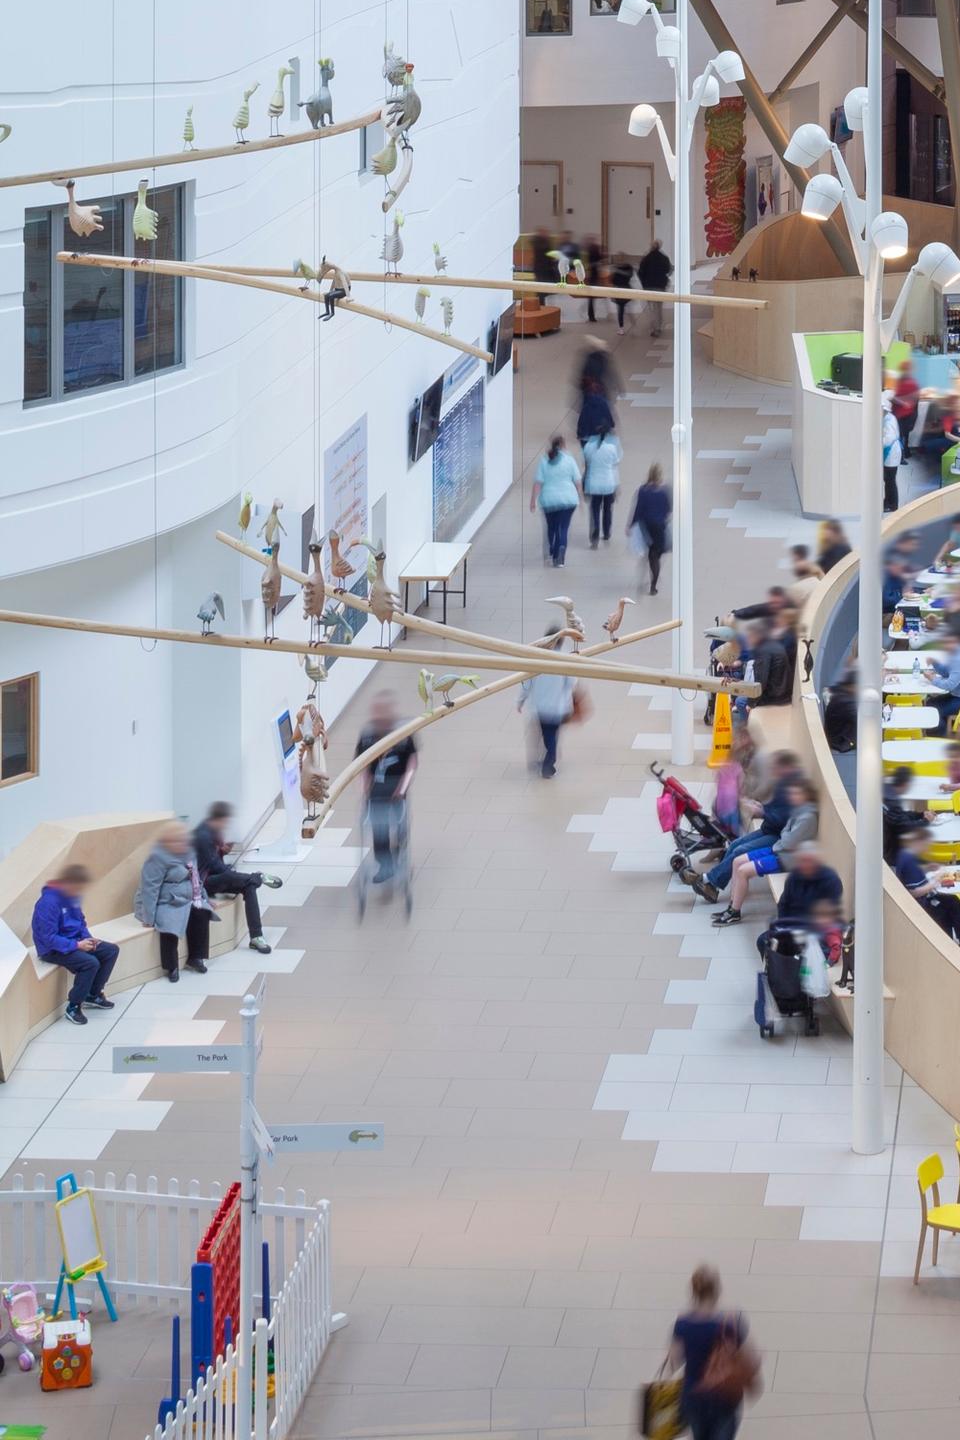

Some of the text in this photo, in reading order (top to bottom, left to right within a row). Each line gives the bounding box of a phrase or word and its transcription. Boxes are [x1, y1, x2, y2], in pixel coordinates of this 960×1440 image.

[197, 1053, 228, 1062] The Park
[282, 1134, 298, 1142] Park
